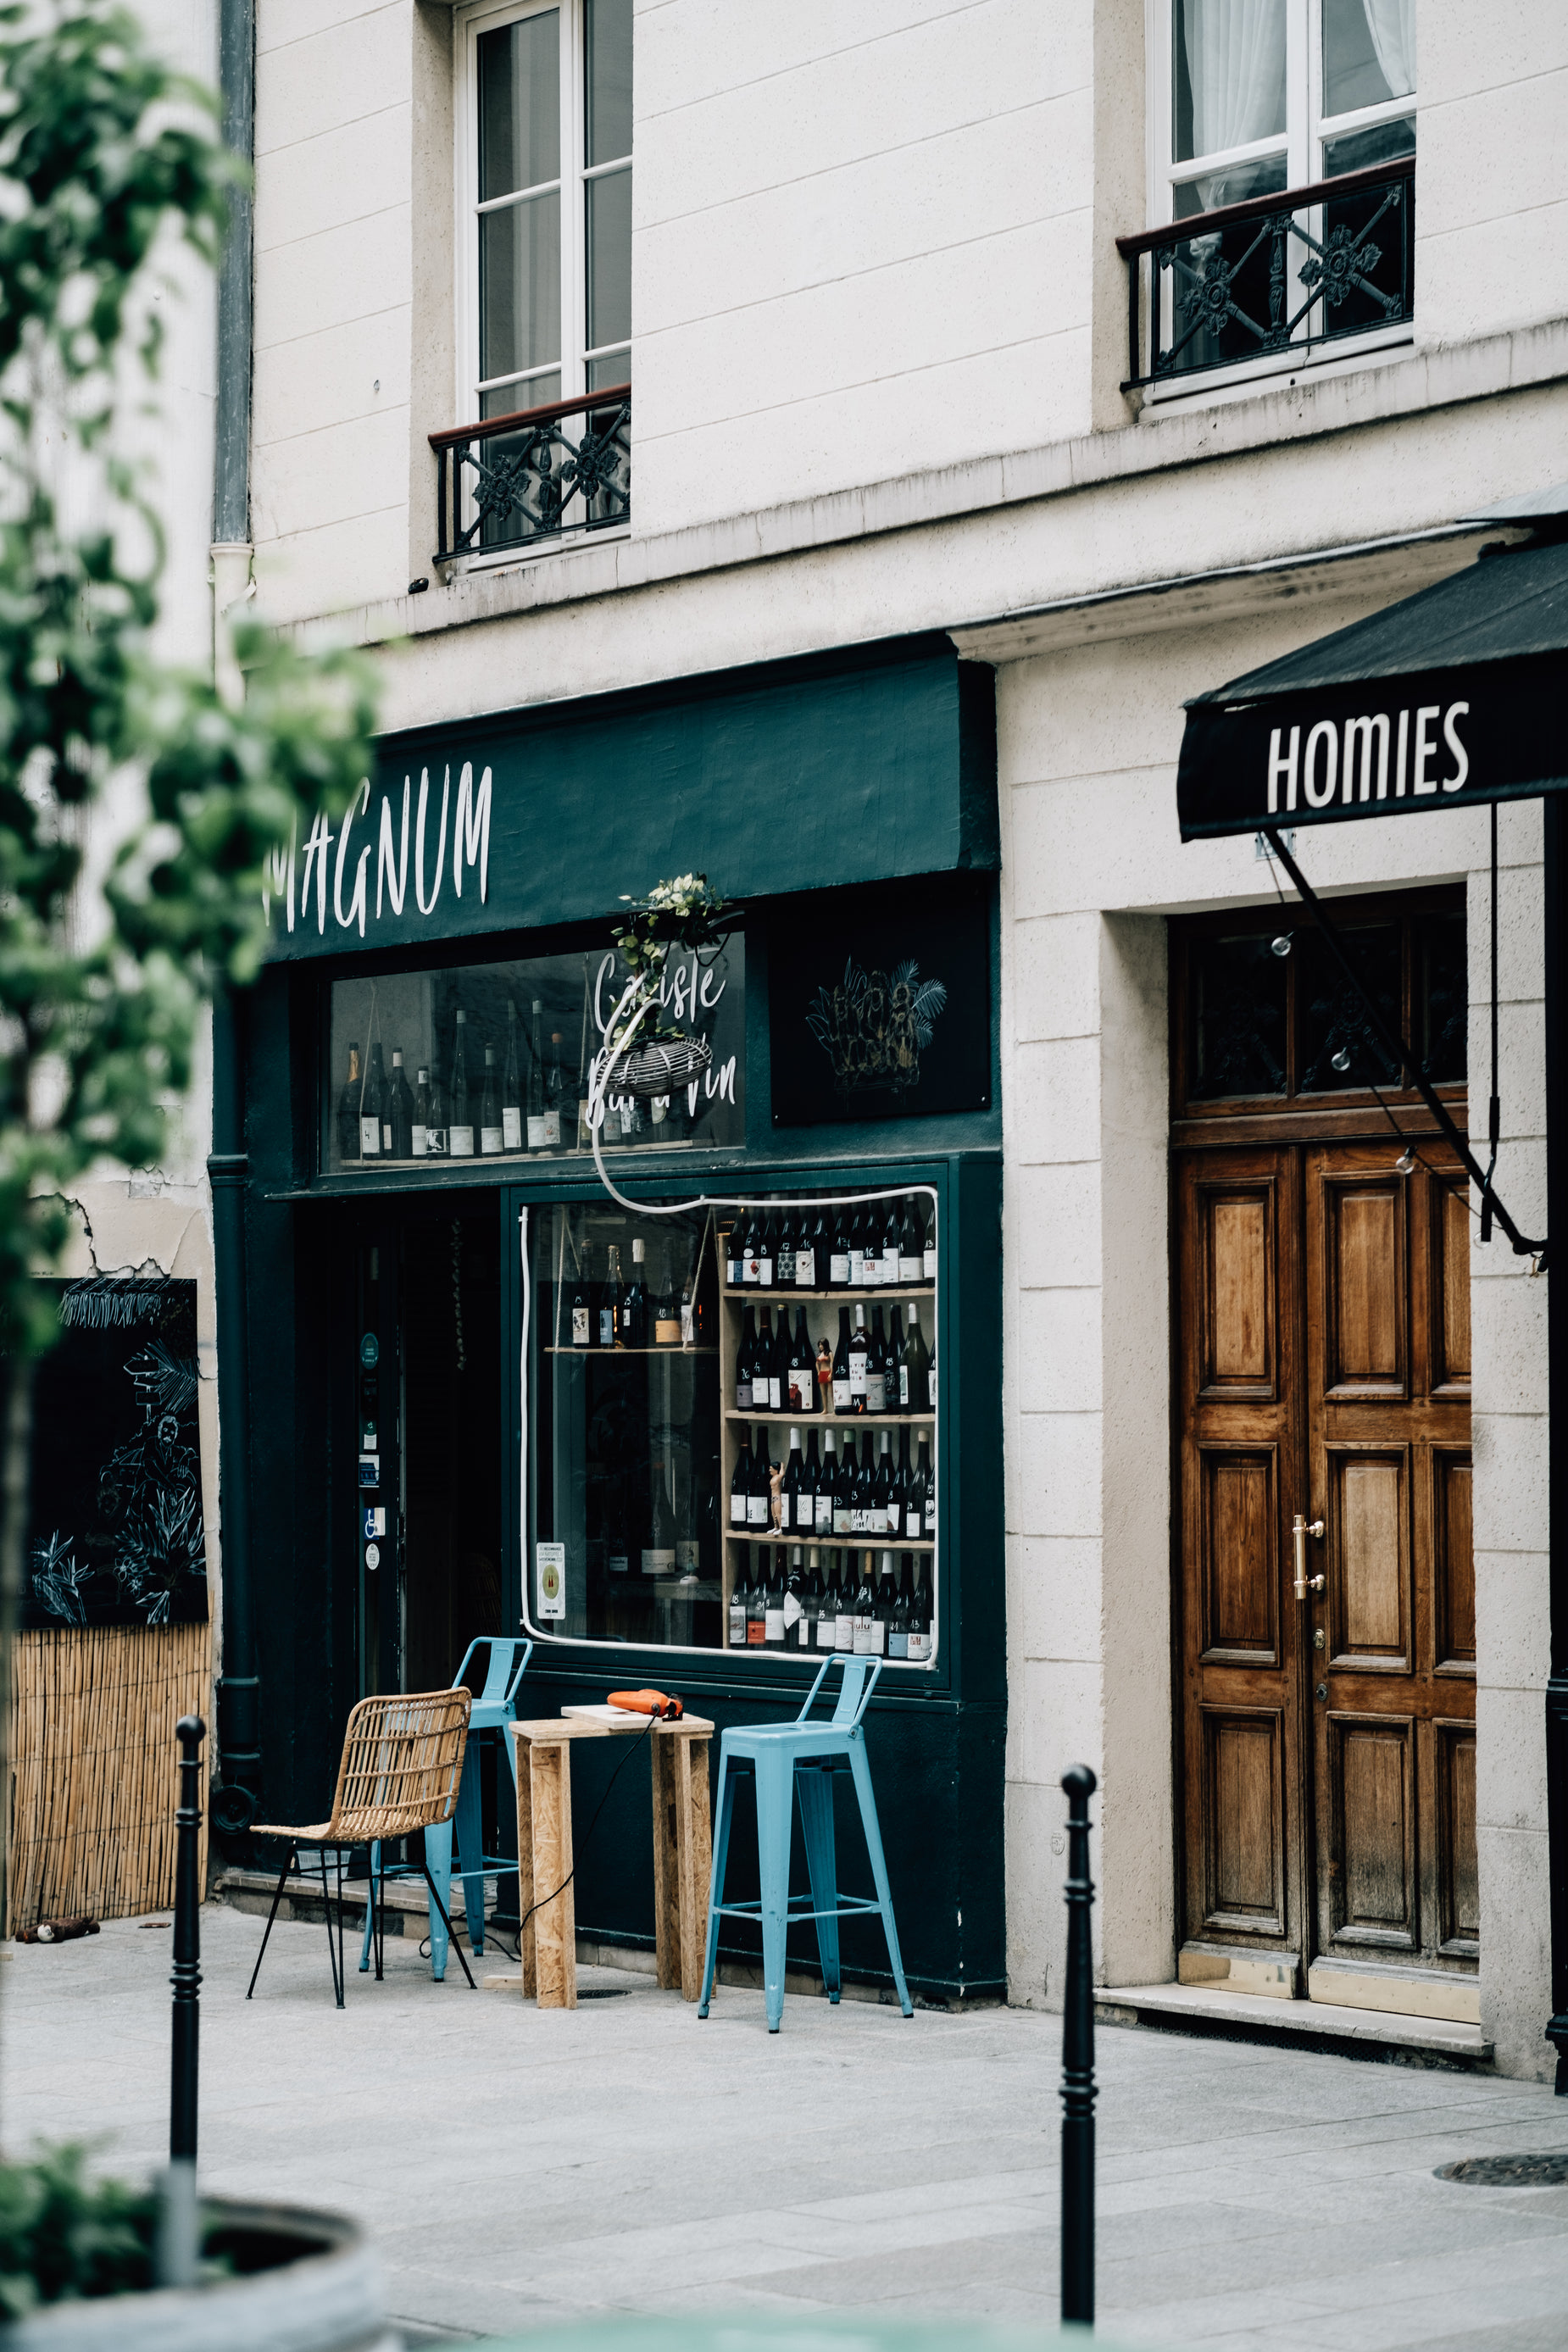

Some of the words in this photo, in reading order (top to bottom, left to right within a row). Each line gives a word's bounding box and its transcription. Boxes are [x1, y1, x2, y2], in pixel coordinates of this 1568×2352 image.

[262, 761, 492, 937] MAGNUM
[595, 944, 726, 1034] Caiste
[924, 1239, 934, 1248] 13
[865, 1247, 874, 1258] 16
[885, 1357, 894, 1366] 18
[836, 1365, 847, 1374] 13
[731, 1594, 739, 1604] 18
[755, 1601, 765, 1612] 21
[911, 1619, 920, 1629] 13
